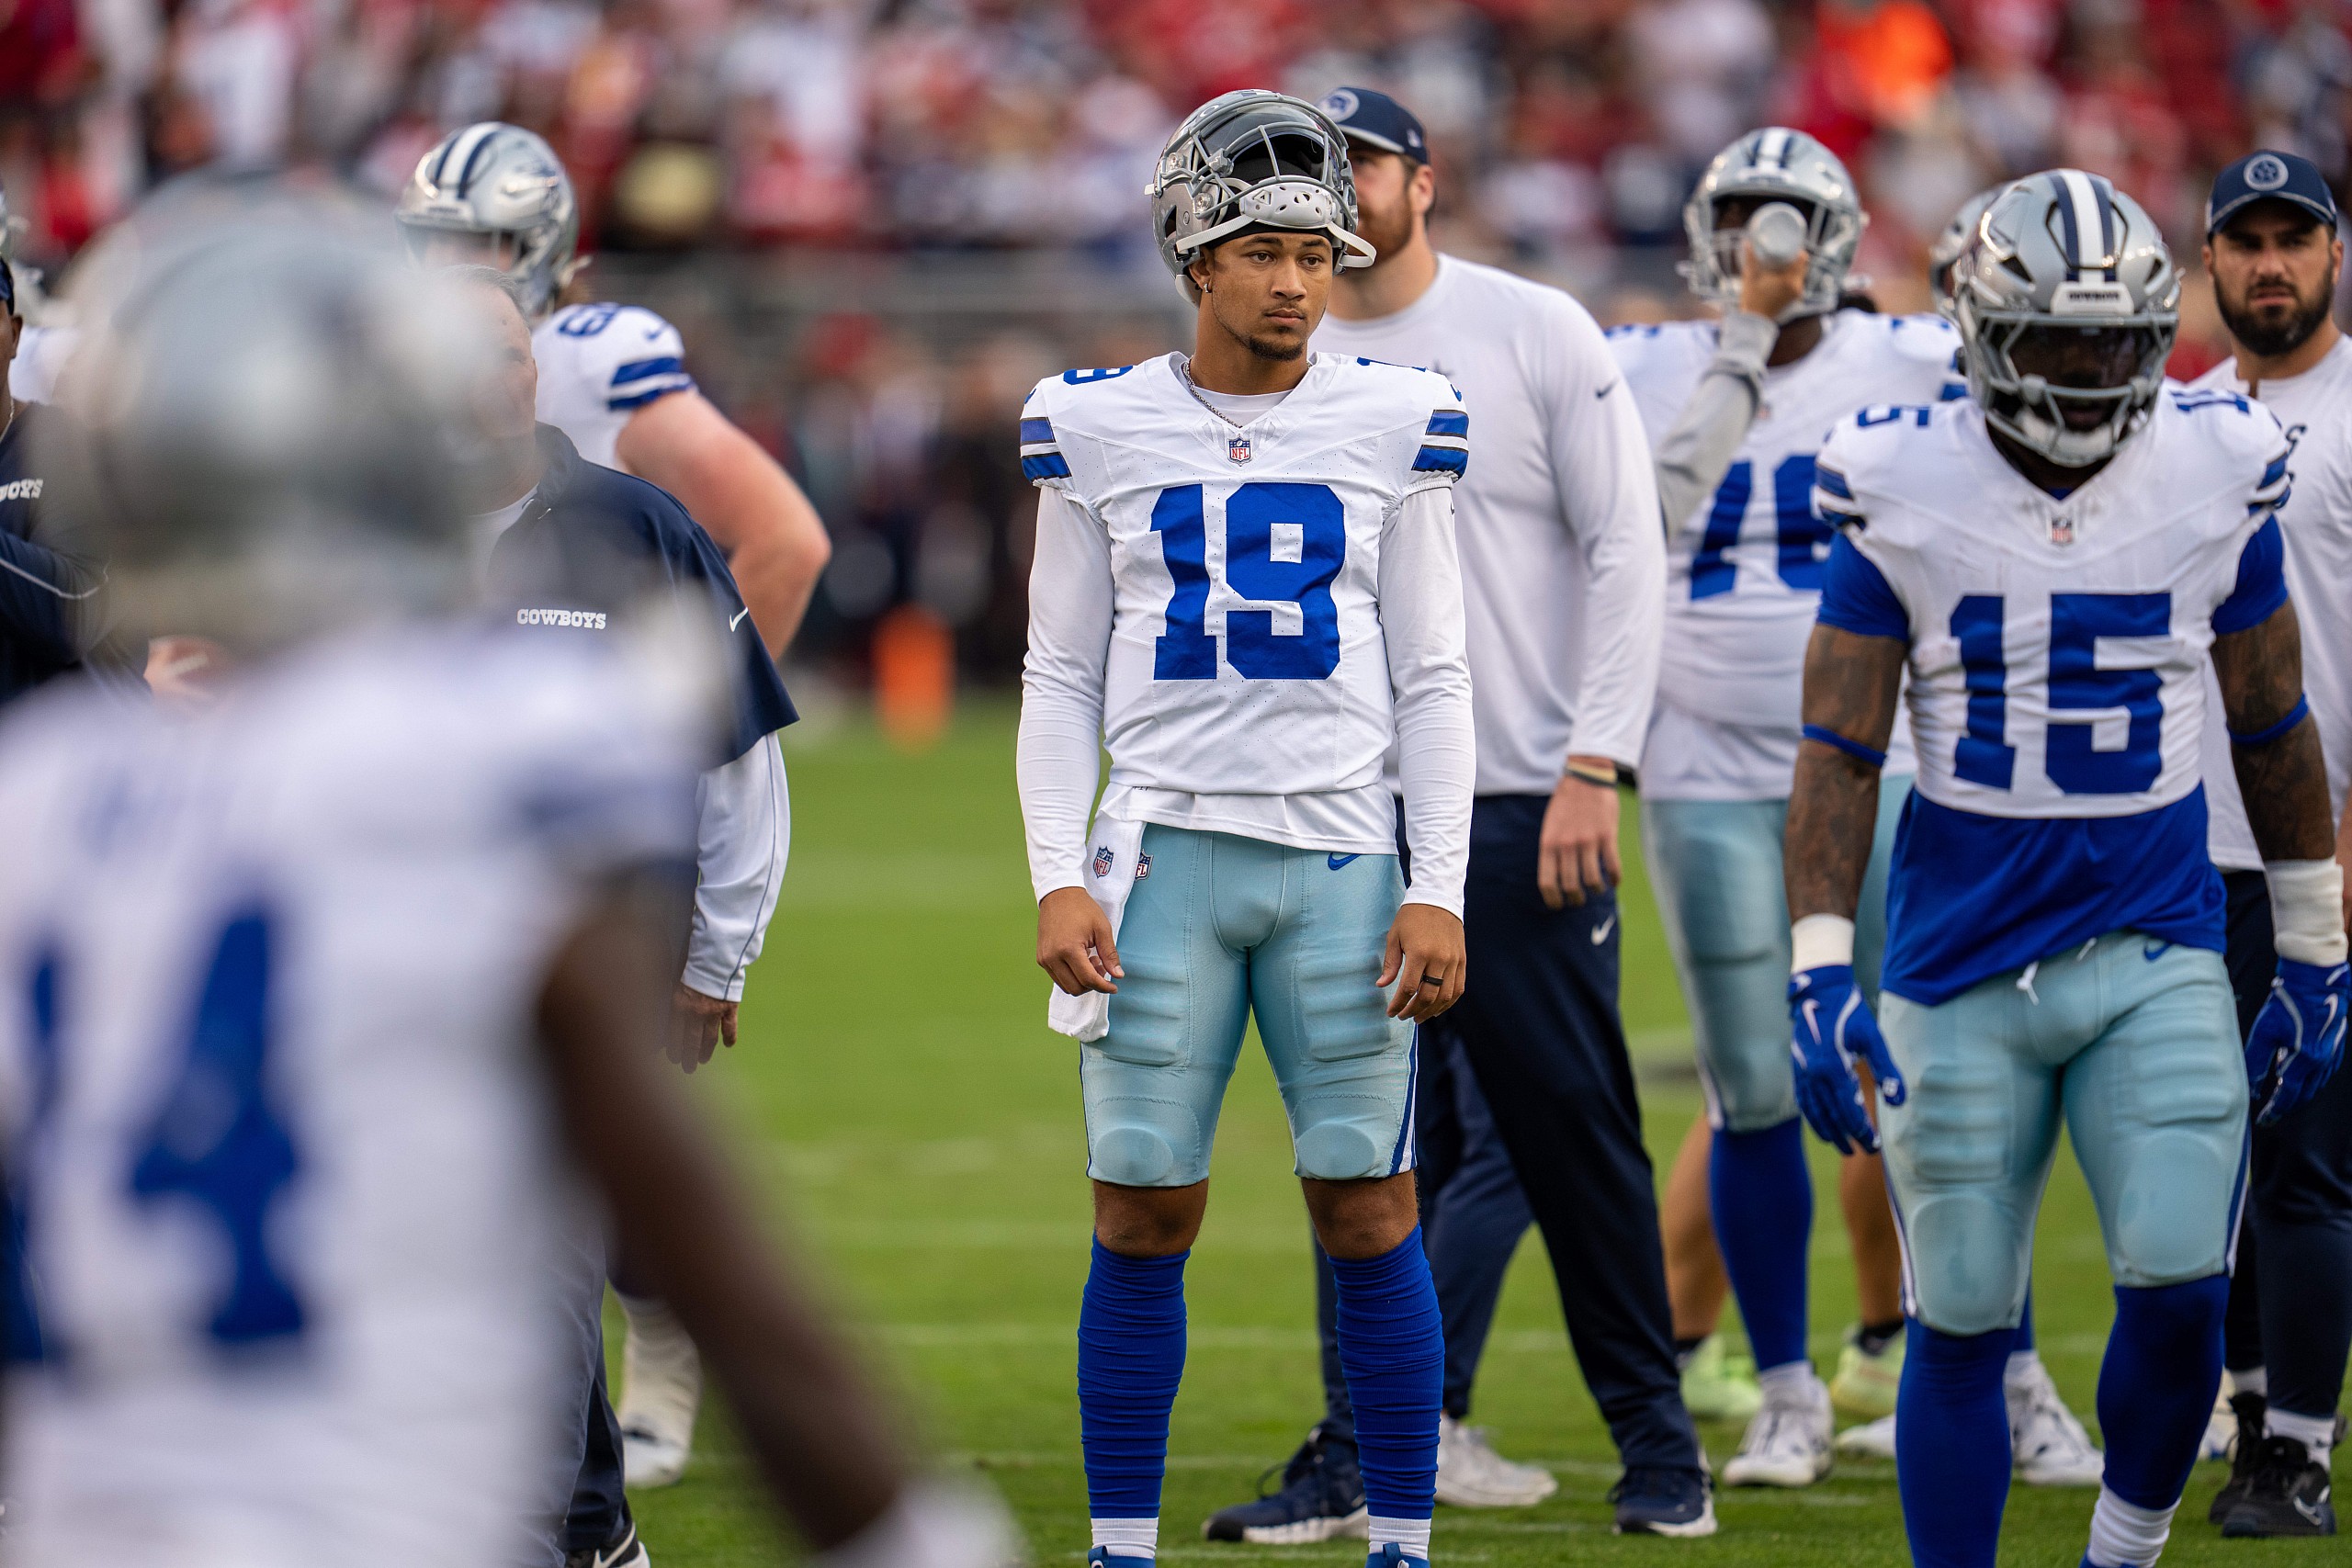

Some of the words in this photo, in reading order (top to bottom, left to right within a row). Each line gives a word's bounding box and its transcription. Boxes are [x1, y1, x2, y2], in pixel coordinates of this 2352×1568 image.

[1231, 447, 1250, 459] NFL
[1150, 483, 1345, 680] 19
[516, 608, 606, 630] COWBOYS
[1950, 592, 2172, 795] 15
[1095, 858, 1109, 876] NFL
[1136, 863, 1148, 876] FL
